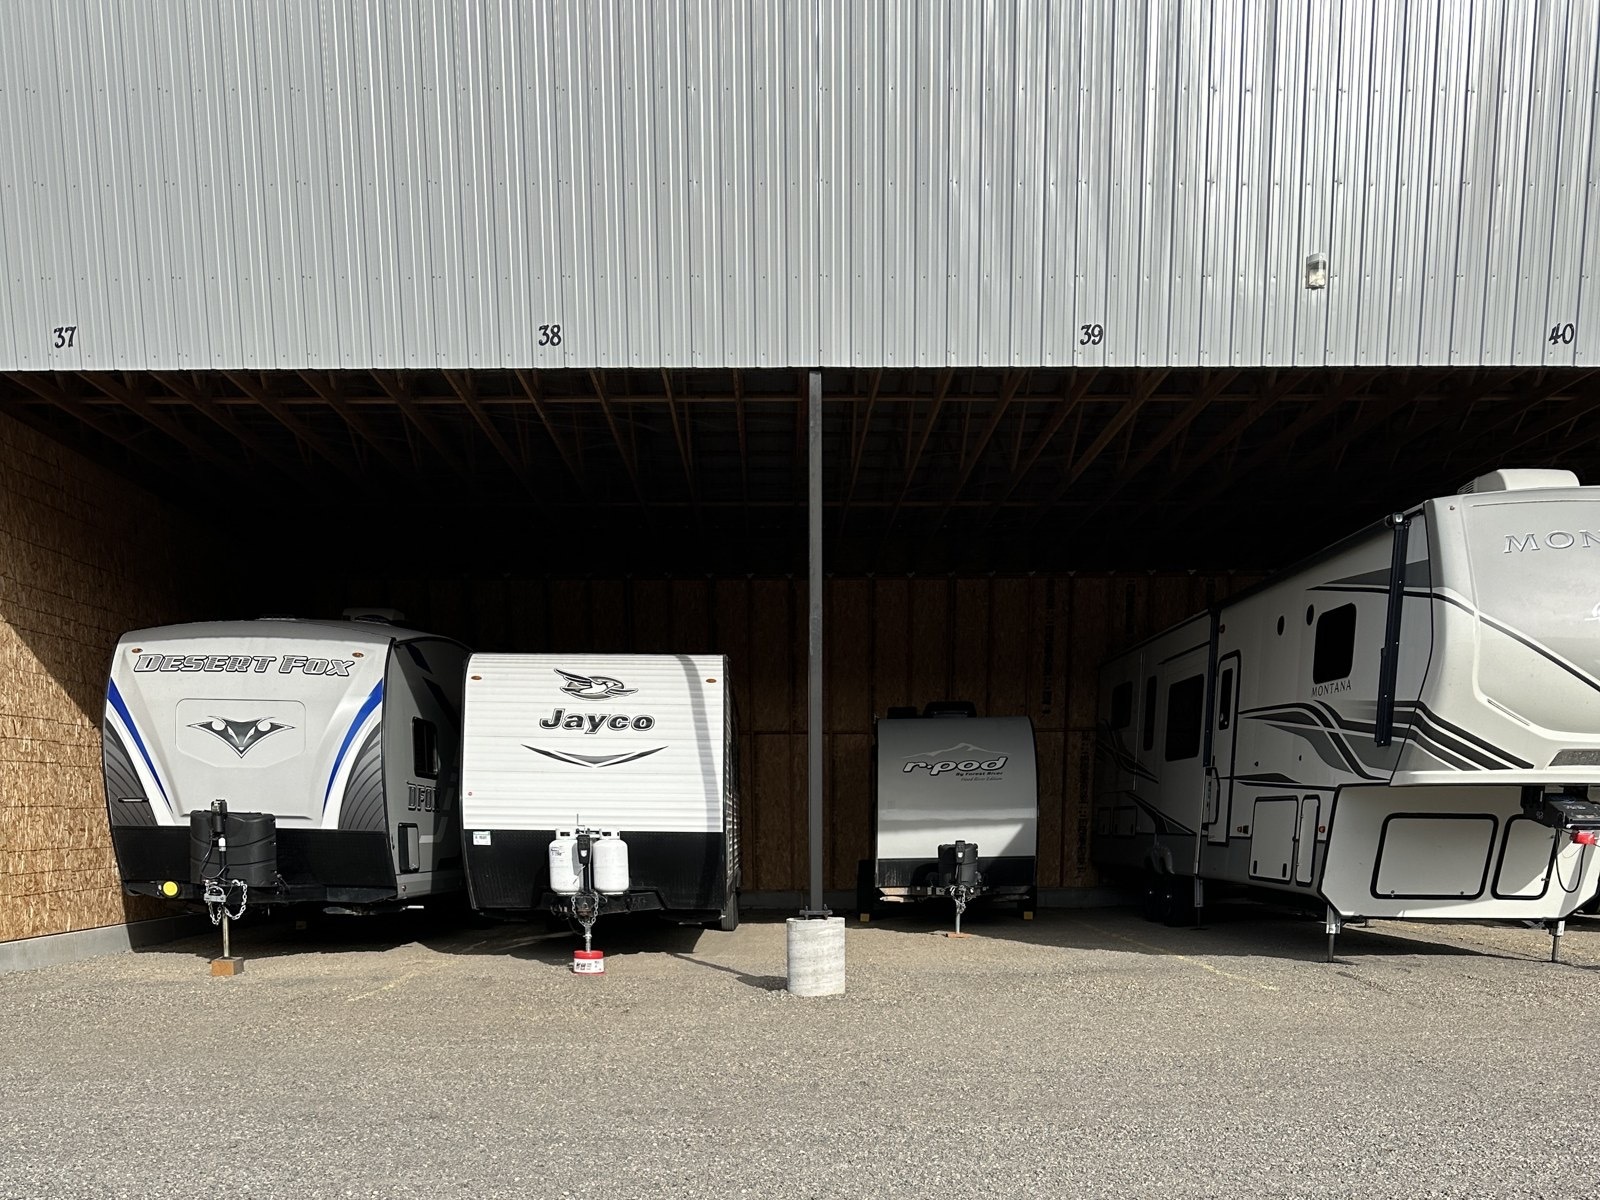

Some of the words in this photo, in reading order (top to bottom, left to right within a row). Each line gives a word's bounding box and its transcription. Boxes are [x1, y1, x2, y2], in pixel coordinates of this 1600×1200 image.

[53, 325, 77, 349] 37
[538, 324, 562, 347] 38
[1079, 323, 1104, 346] 39
[1548, 322, 1575, 346] 40
[133, 652, 277, 674] DESERT
[279, 654, 355, 677] FOX
[1310, 679, 1352, 698] MONTANA
[538, 707, 656, 735] Jayco
